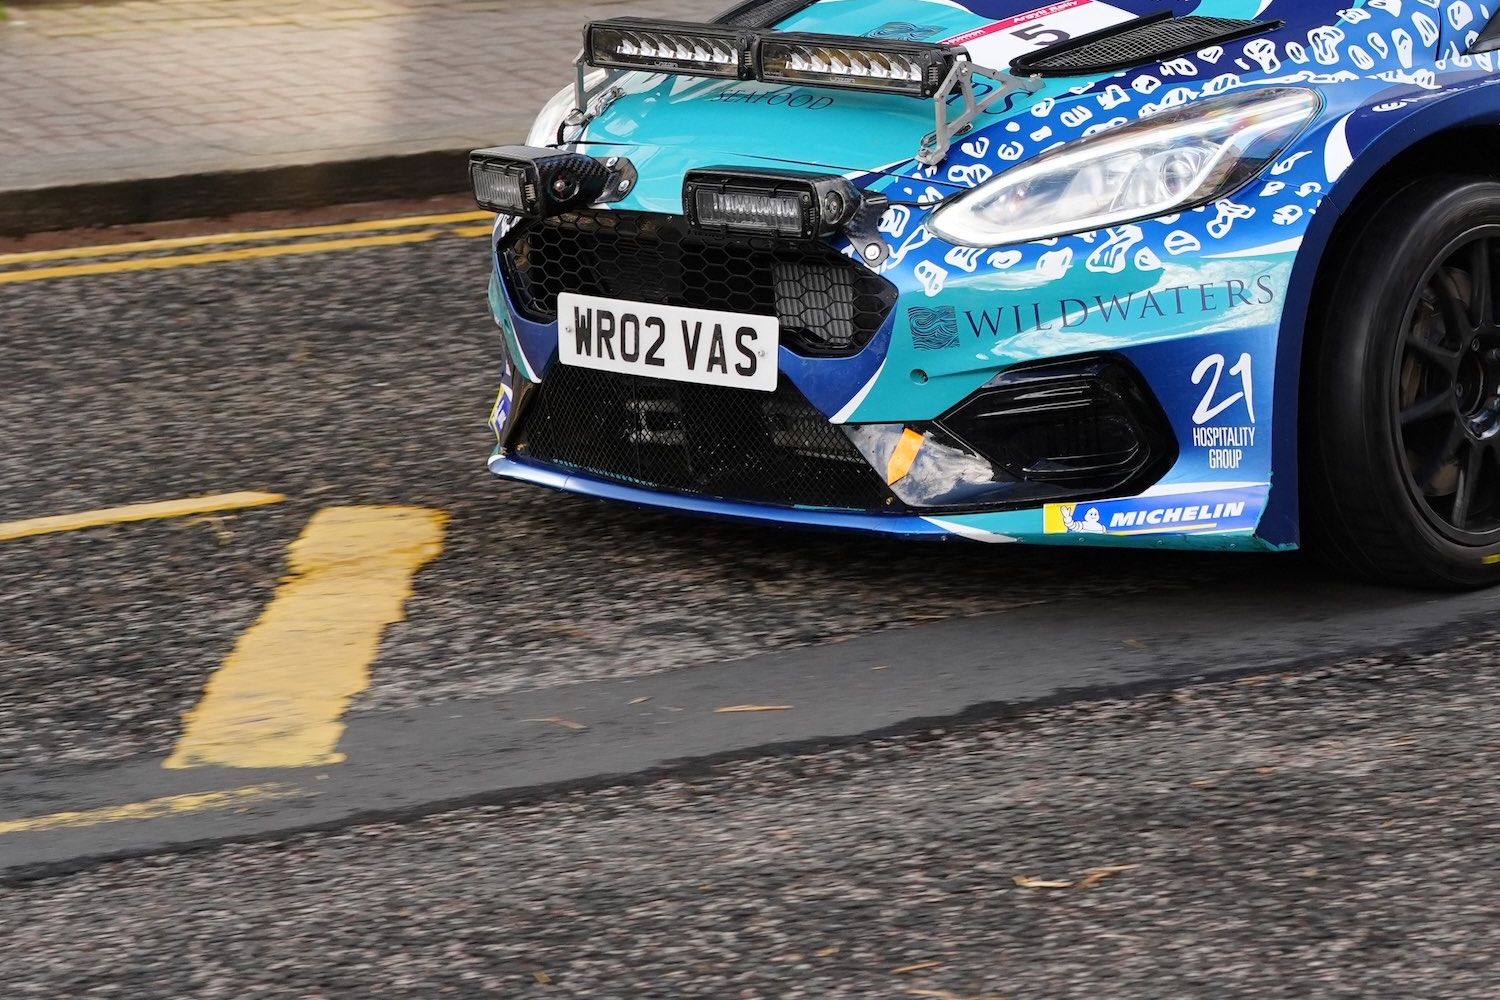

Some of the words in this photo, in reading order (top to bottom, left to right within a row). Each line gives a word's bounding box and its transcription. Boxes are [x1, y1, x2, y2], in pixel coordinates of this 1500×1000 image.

[1049, 0, 1079, 15] Rally
[1009, 23, 1071, 46] 5
[709, 89, 835, 111] SEAFOOD
[964, 274, 1275, 339] WILDWATERS
[572, 306, 667, 369] WR02
[681, 319, 760, 378] VAS
[1189, 352, 1256, 425] 21
[1192, 425, 1256, 448] HOSPITALITY
[1208, 448, 1243, 470] GROUP
[1108, 501, 1246, 529] MICHELIN
